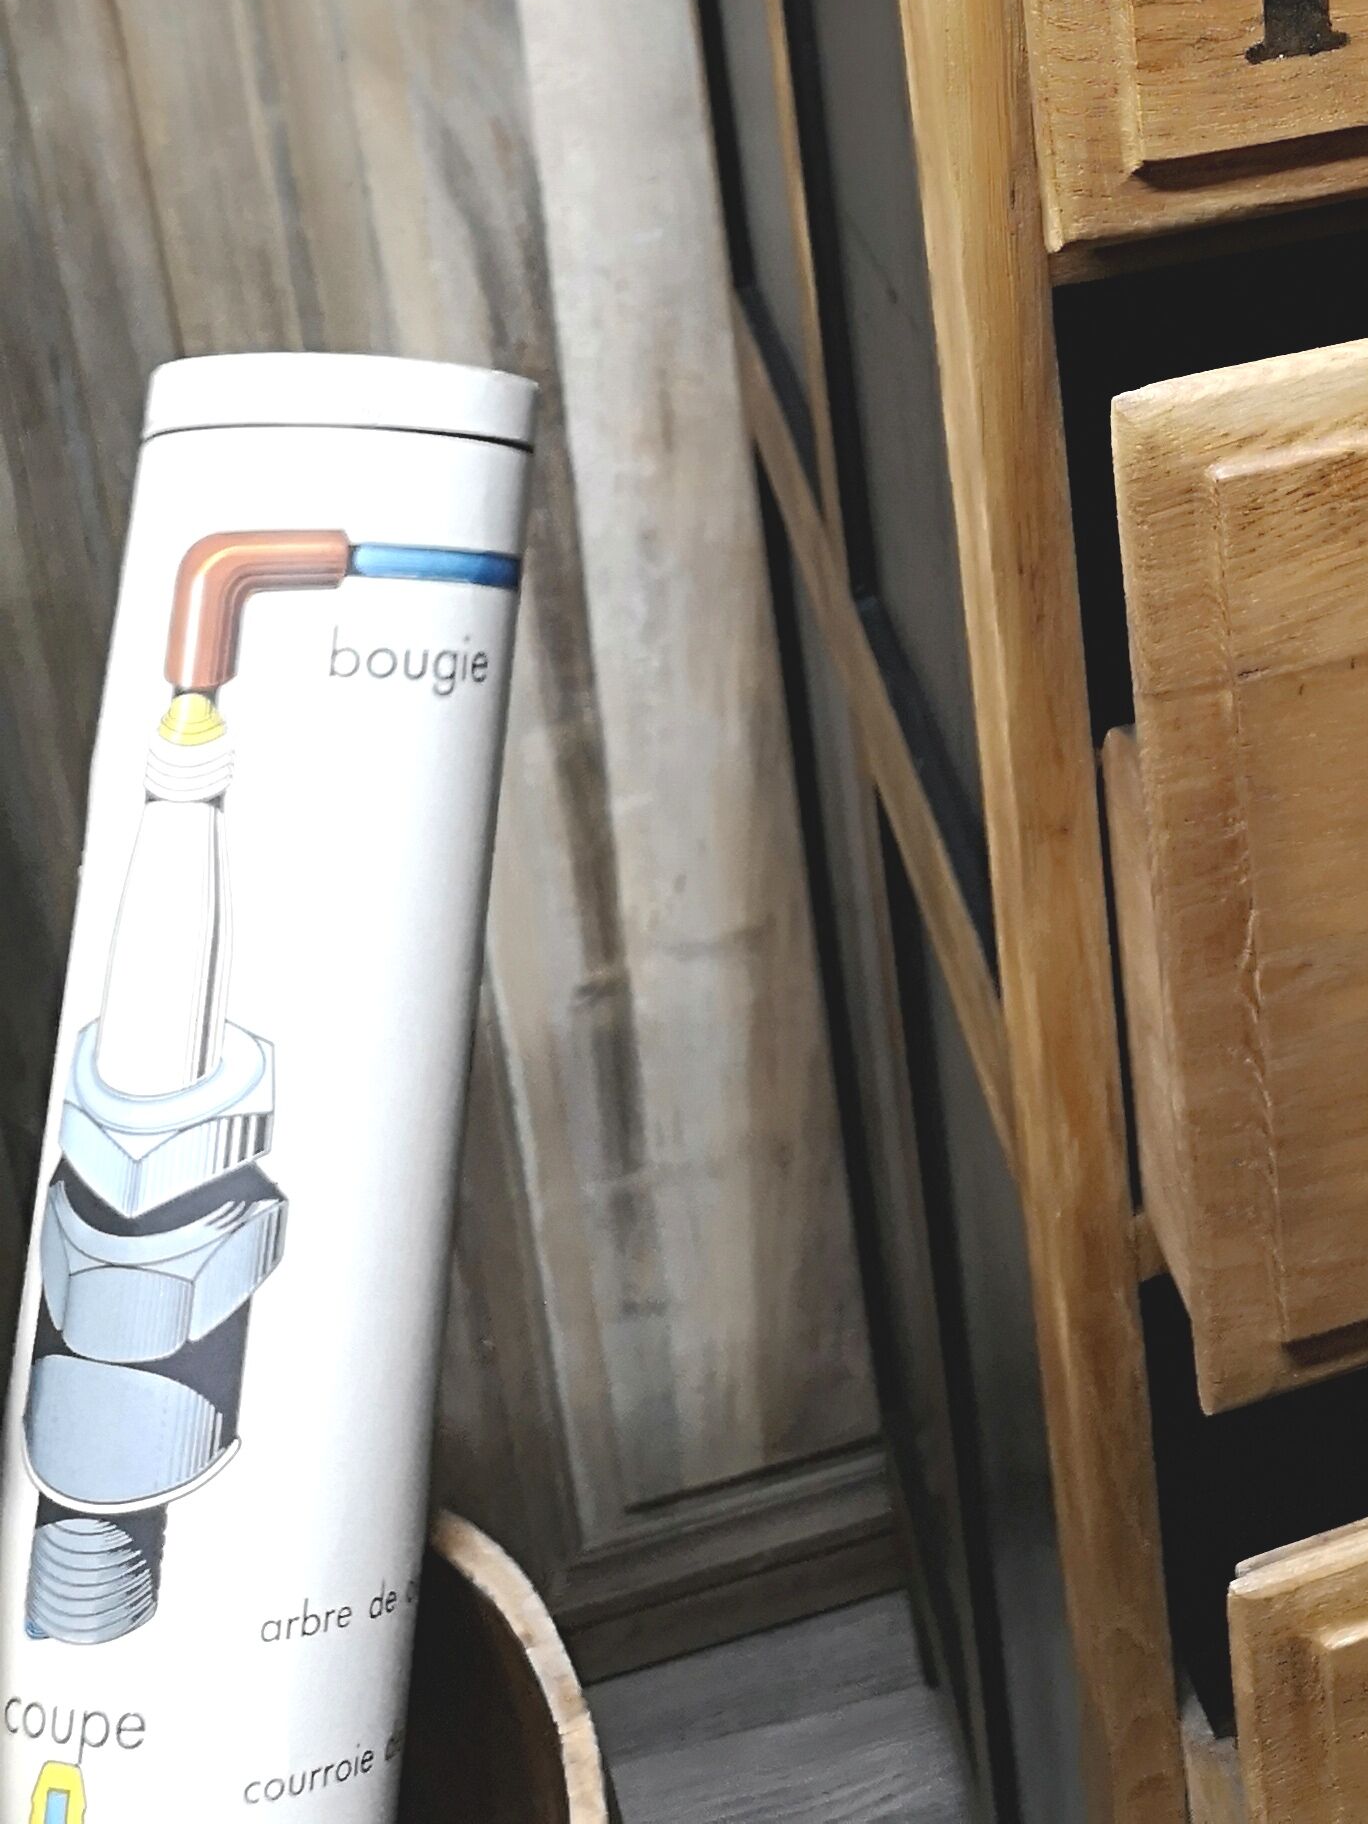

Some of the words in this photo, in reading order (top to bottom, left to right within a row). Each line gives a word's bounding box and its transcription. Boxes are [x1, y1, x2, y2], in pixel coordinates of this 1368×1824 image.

[328, 626, 489, 695] bougie
[259, 1597, 353, 1644] arbre
[368, 1576, 398, 1619] de
[3, 1694, 147, 1766] coupe
[243, 1741, 375, 1806] courroie
